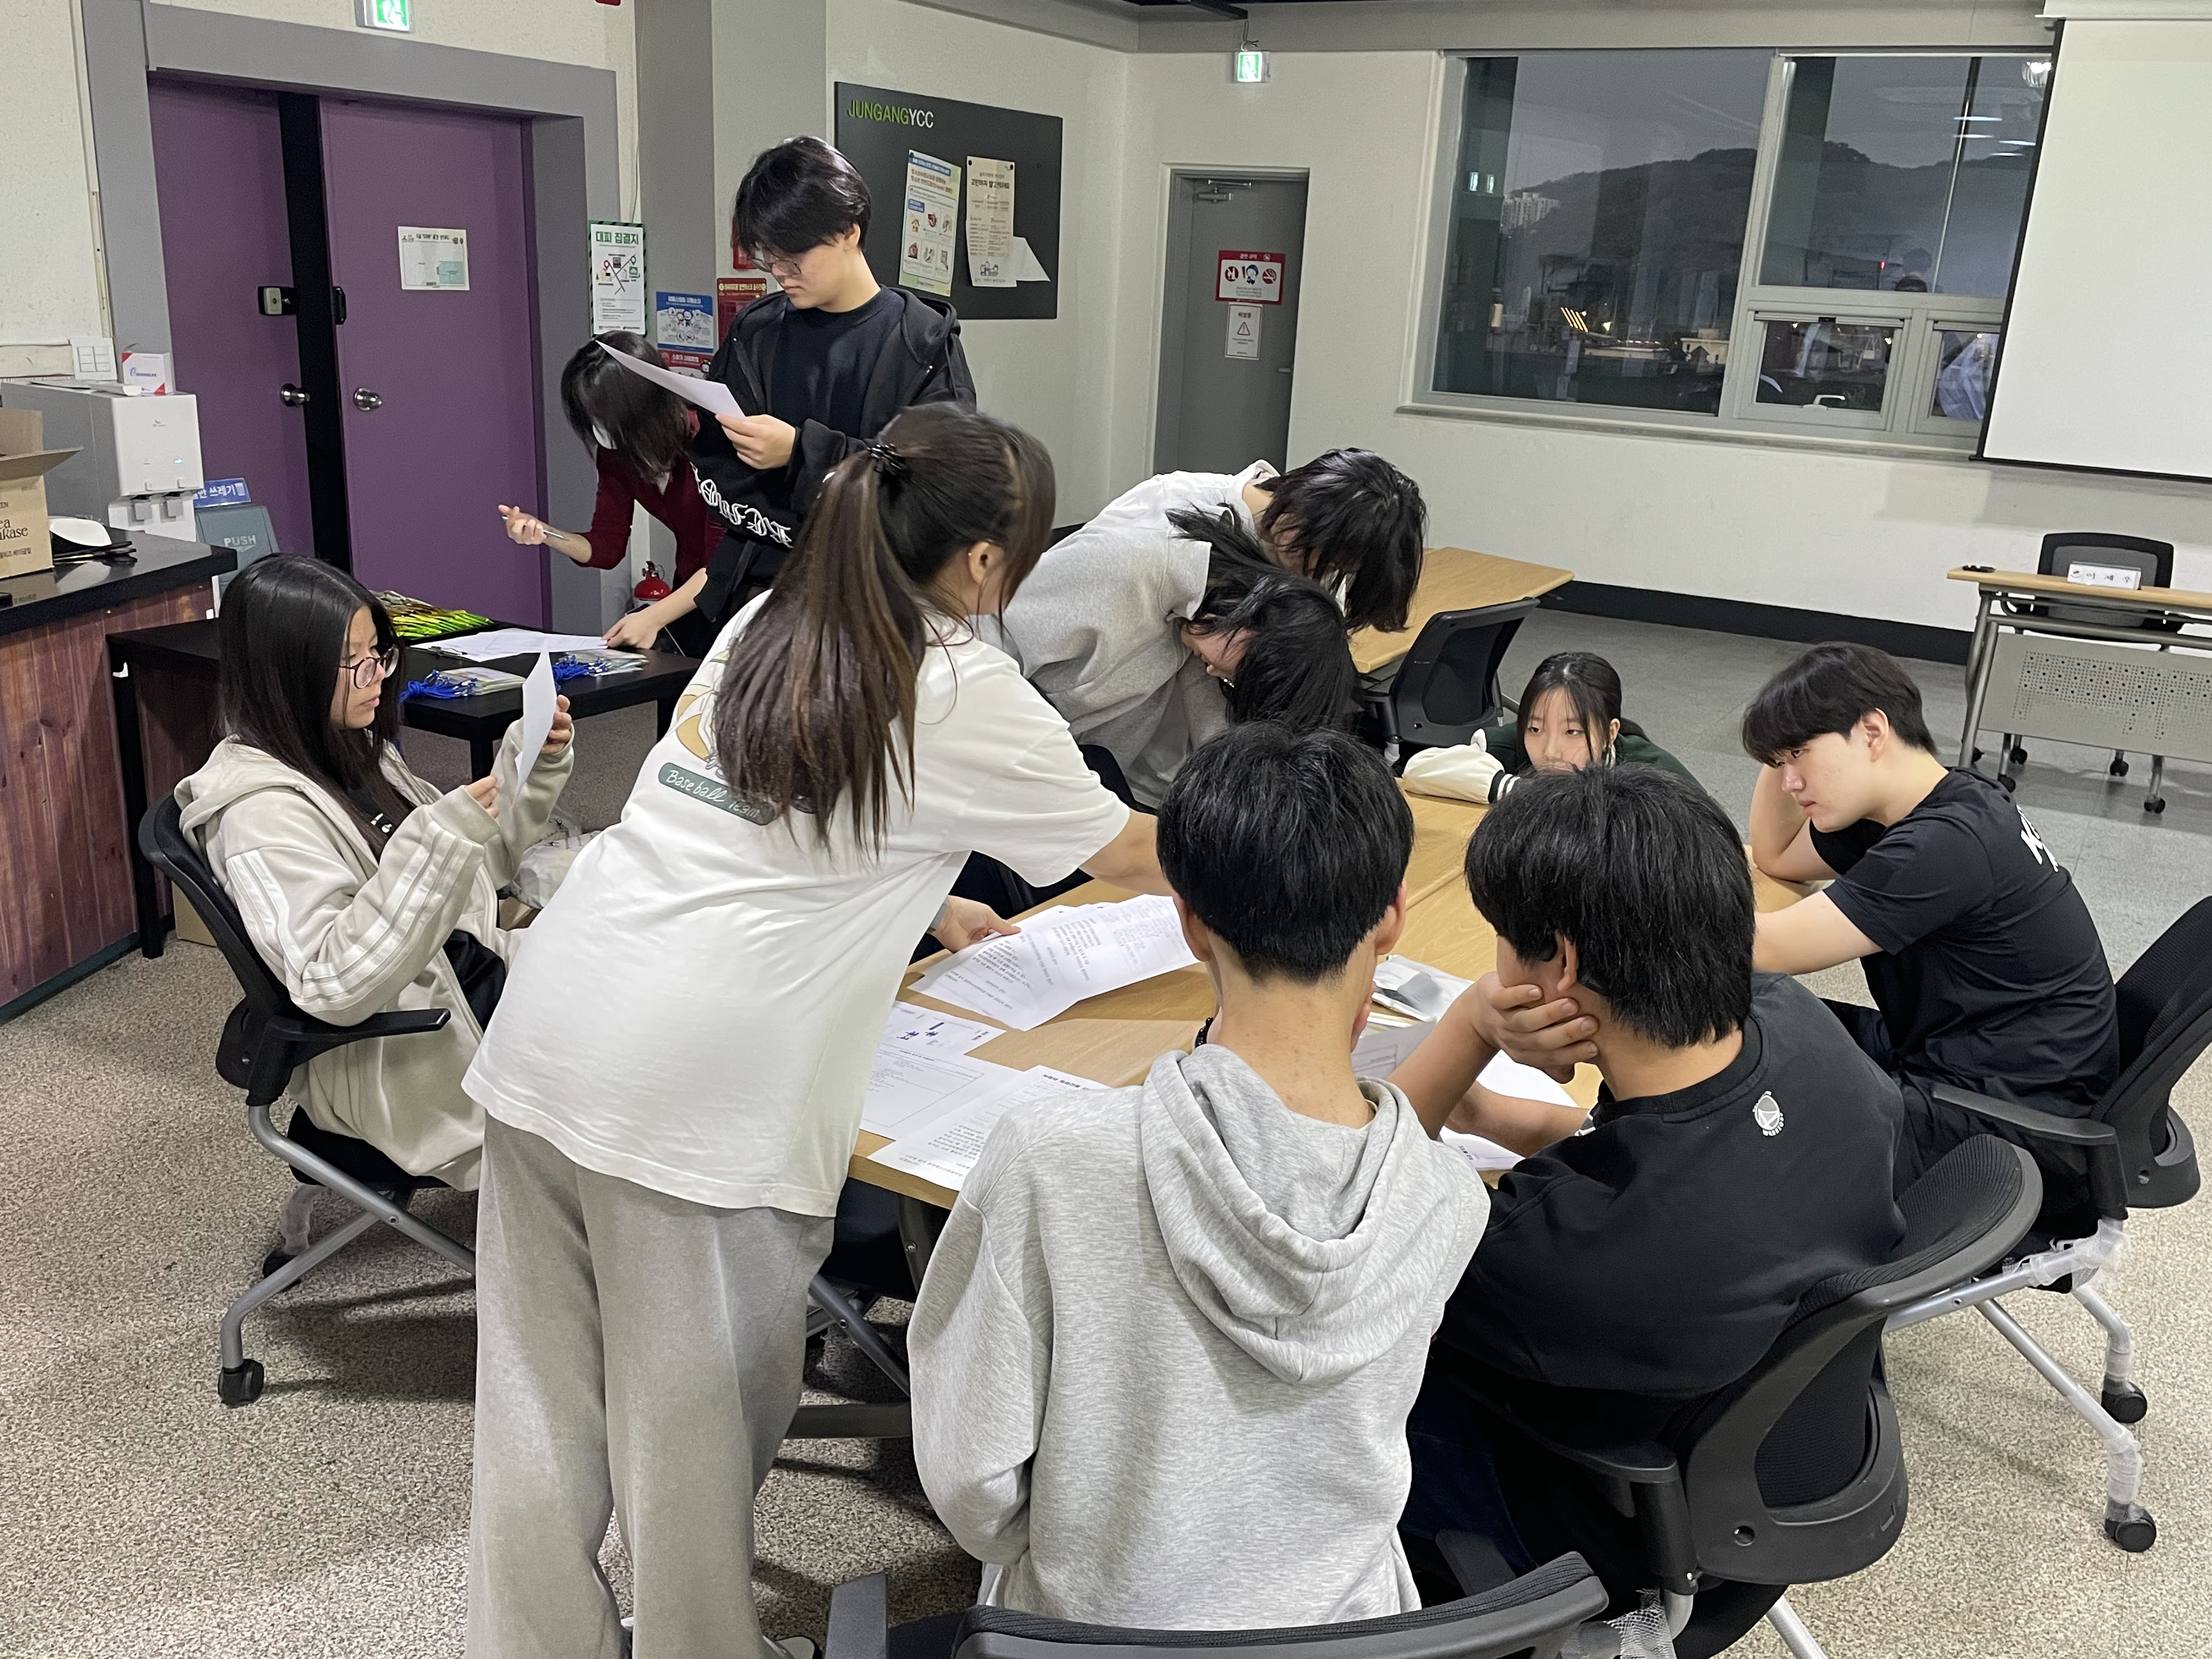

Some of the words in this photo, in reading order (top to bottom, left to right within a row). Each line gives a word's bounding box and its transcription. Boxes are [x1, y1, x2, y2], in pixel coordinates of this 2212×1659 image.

[848, 99, 934, 128] JUNGANGYCC
[596, 231, 612, 243] 대피
[615, 233, 639, 245] 집결지
[209, 484, 236, 497] 쓰레기
[224, 535, 257, 547] PUSH
